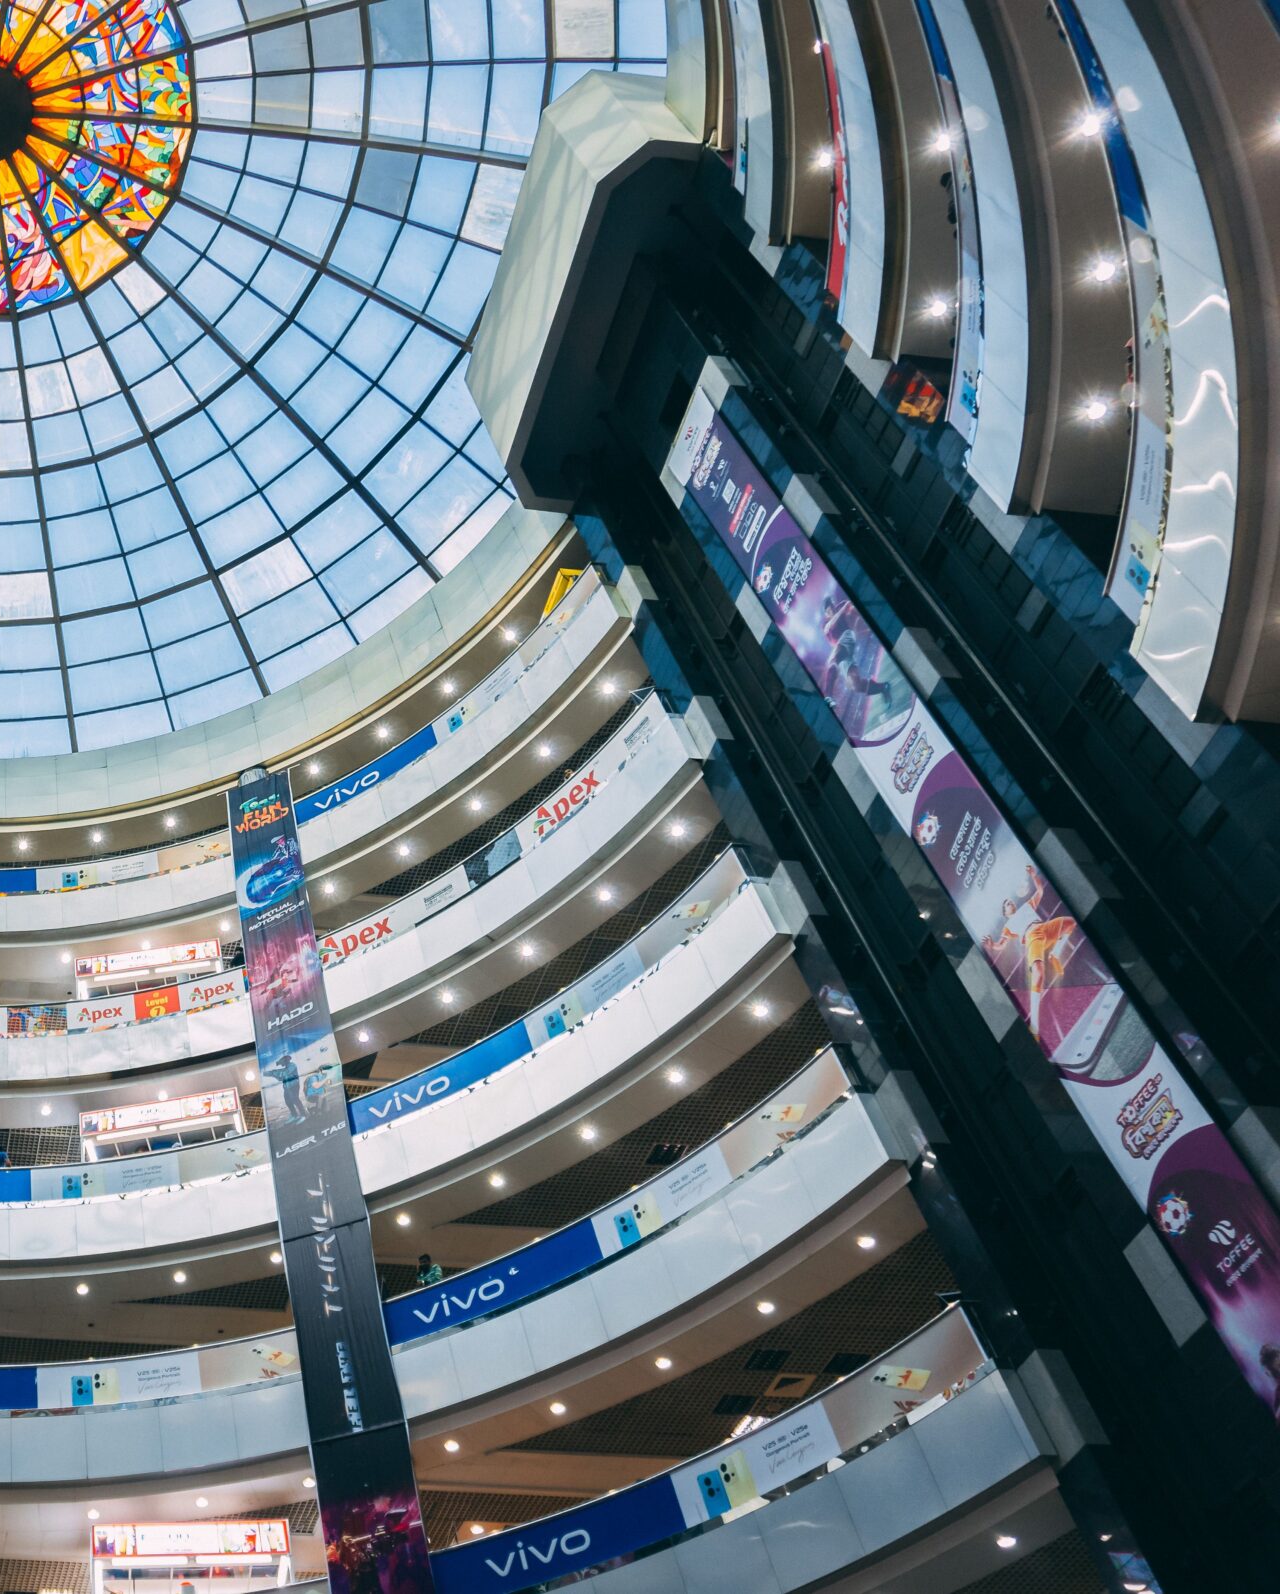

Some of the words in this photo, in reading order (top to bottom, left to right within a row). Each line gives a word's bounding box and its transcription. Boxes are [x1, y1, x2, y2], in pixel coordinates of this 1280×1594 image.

[314, 771, 379, 809] vivo
[533, 770, 600, 836] Apex
[235, 806, 288, 833] WORLD
[242, 801, 283, 822] FUN
[950, 811, 972, 860] যেকোনো
[957, 816, 982, 876] নেটওয়ার্কে
[964, 861, 978, 889] খেলা
[976, 828, 992, 860] দেখুন
[248, 899, 305, 932] MOTORCYCLE
[256, 900, 293, 921] VIRTUAL
[319, 917, 393, 963] Apex
[145, 996, 168, 1007] Level
[189, 981, 235, 1003] Apex
[76, 1006, 123, 1023] Apex
[267, 1001, 314, 1031] HADO
[369, 1076, 450, 1118] vivo
[1119, 1080, 1157, 1126] TOFFEE
[276, 1135, 316, 1158] LASER
[321, 1120, 346, 1137] TAG
[1217, 1233, 1256, 1273] TOFFEE
[413, 1278, 504, 1323] vivo
[762, 1440, 776, 1450] V25
[791, 1425, 808, 1436] V25e
[485, 1529, 590, 1577] vivo
